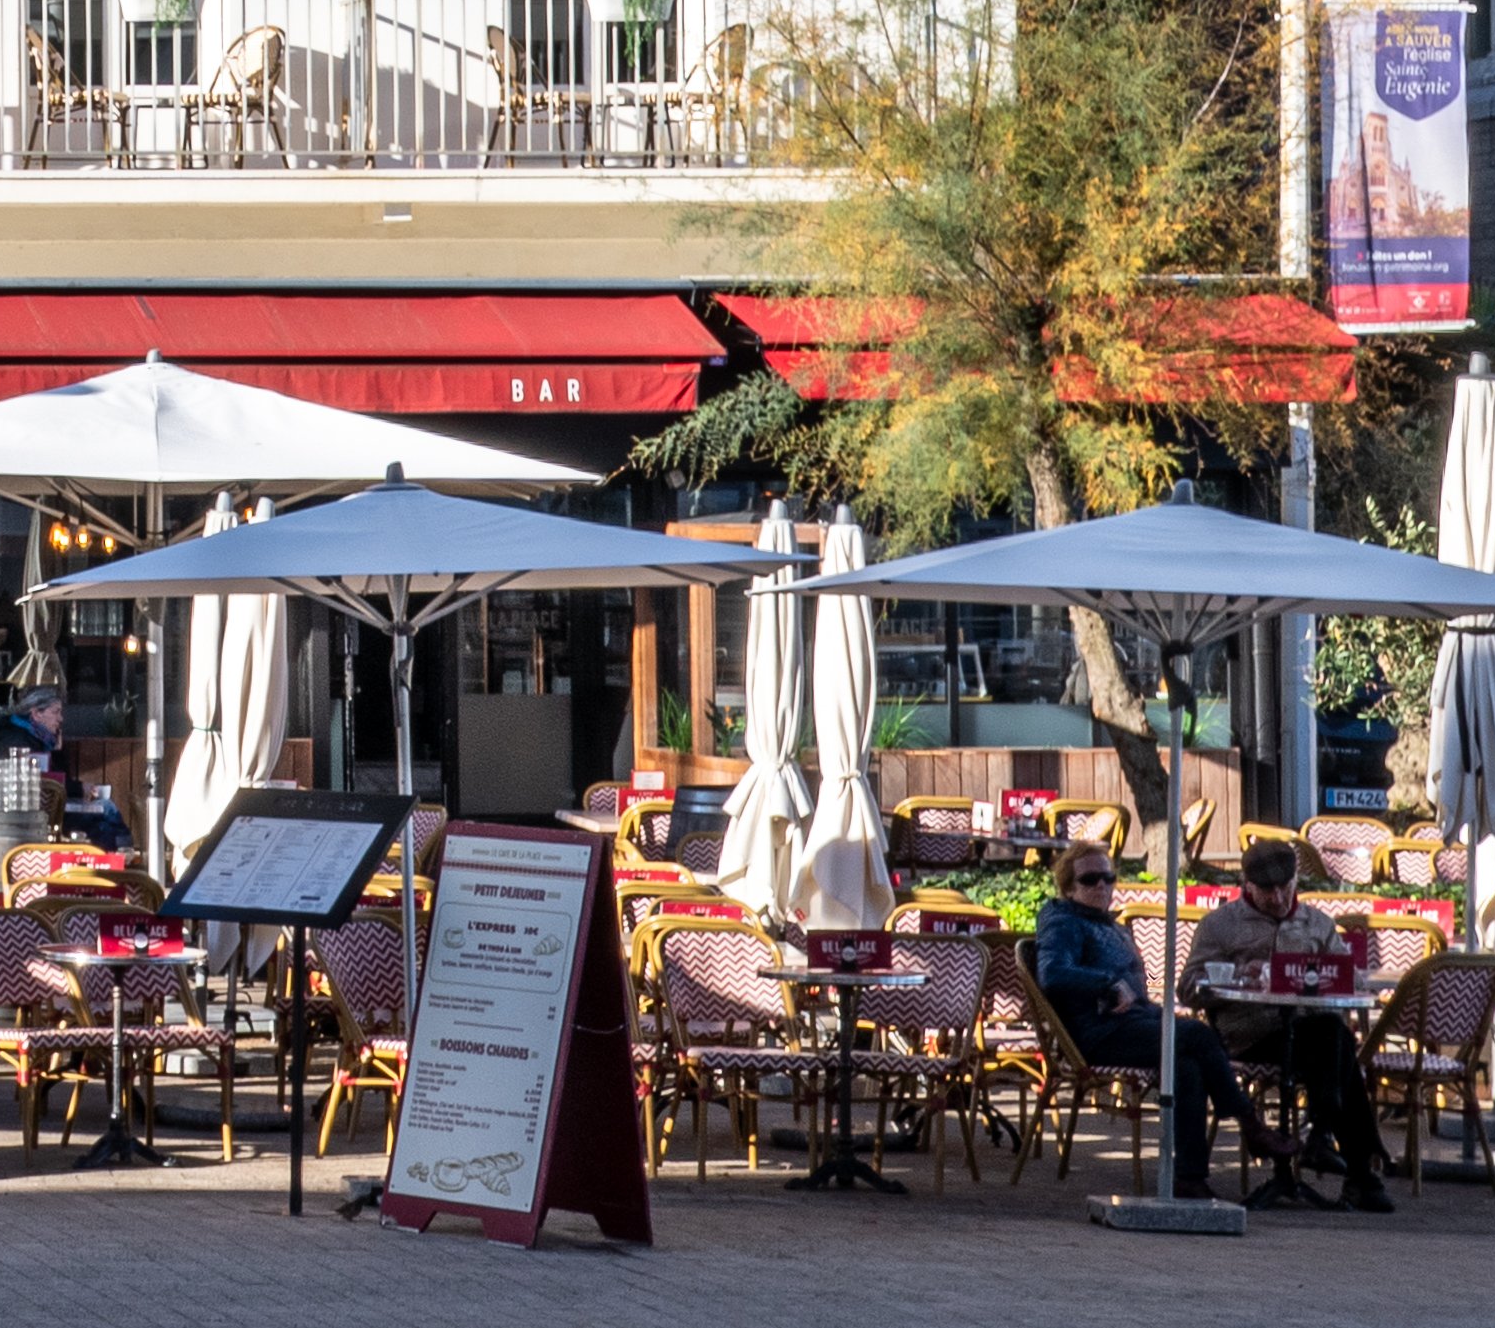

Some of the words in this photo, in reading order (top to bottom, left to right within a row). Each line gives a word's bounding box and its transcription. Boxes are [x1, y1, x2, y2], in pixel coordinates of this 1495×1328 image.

[1396, 34, 1452, 48] SAUVER
[1403, 47, 1452, 64] l'église
[1385, 60, 1429, 80] Sainte
[1393, 251, 1407, 261] un
[1408, 250, 1427, 261] don
[511, 378, 580, 403] BAR
[474, 883, 498, 897] PETIT
[500, 886, 546, 901] DEJEUNER
[113, 925, 124, 937] DE
[468, 920, 516, 934] L'EXPRESS
[933, 921, 945, 932] DE
[1285, 965, 1297, 977] DE
[440, 1038, 485, 1055] BOISSONS
[487, 1044, 529, 1060] CHAUDES
